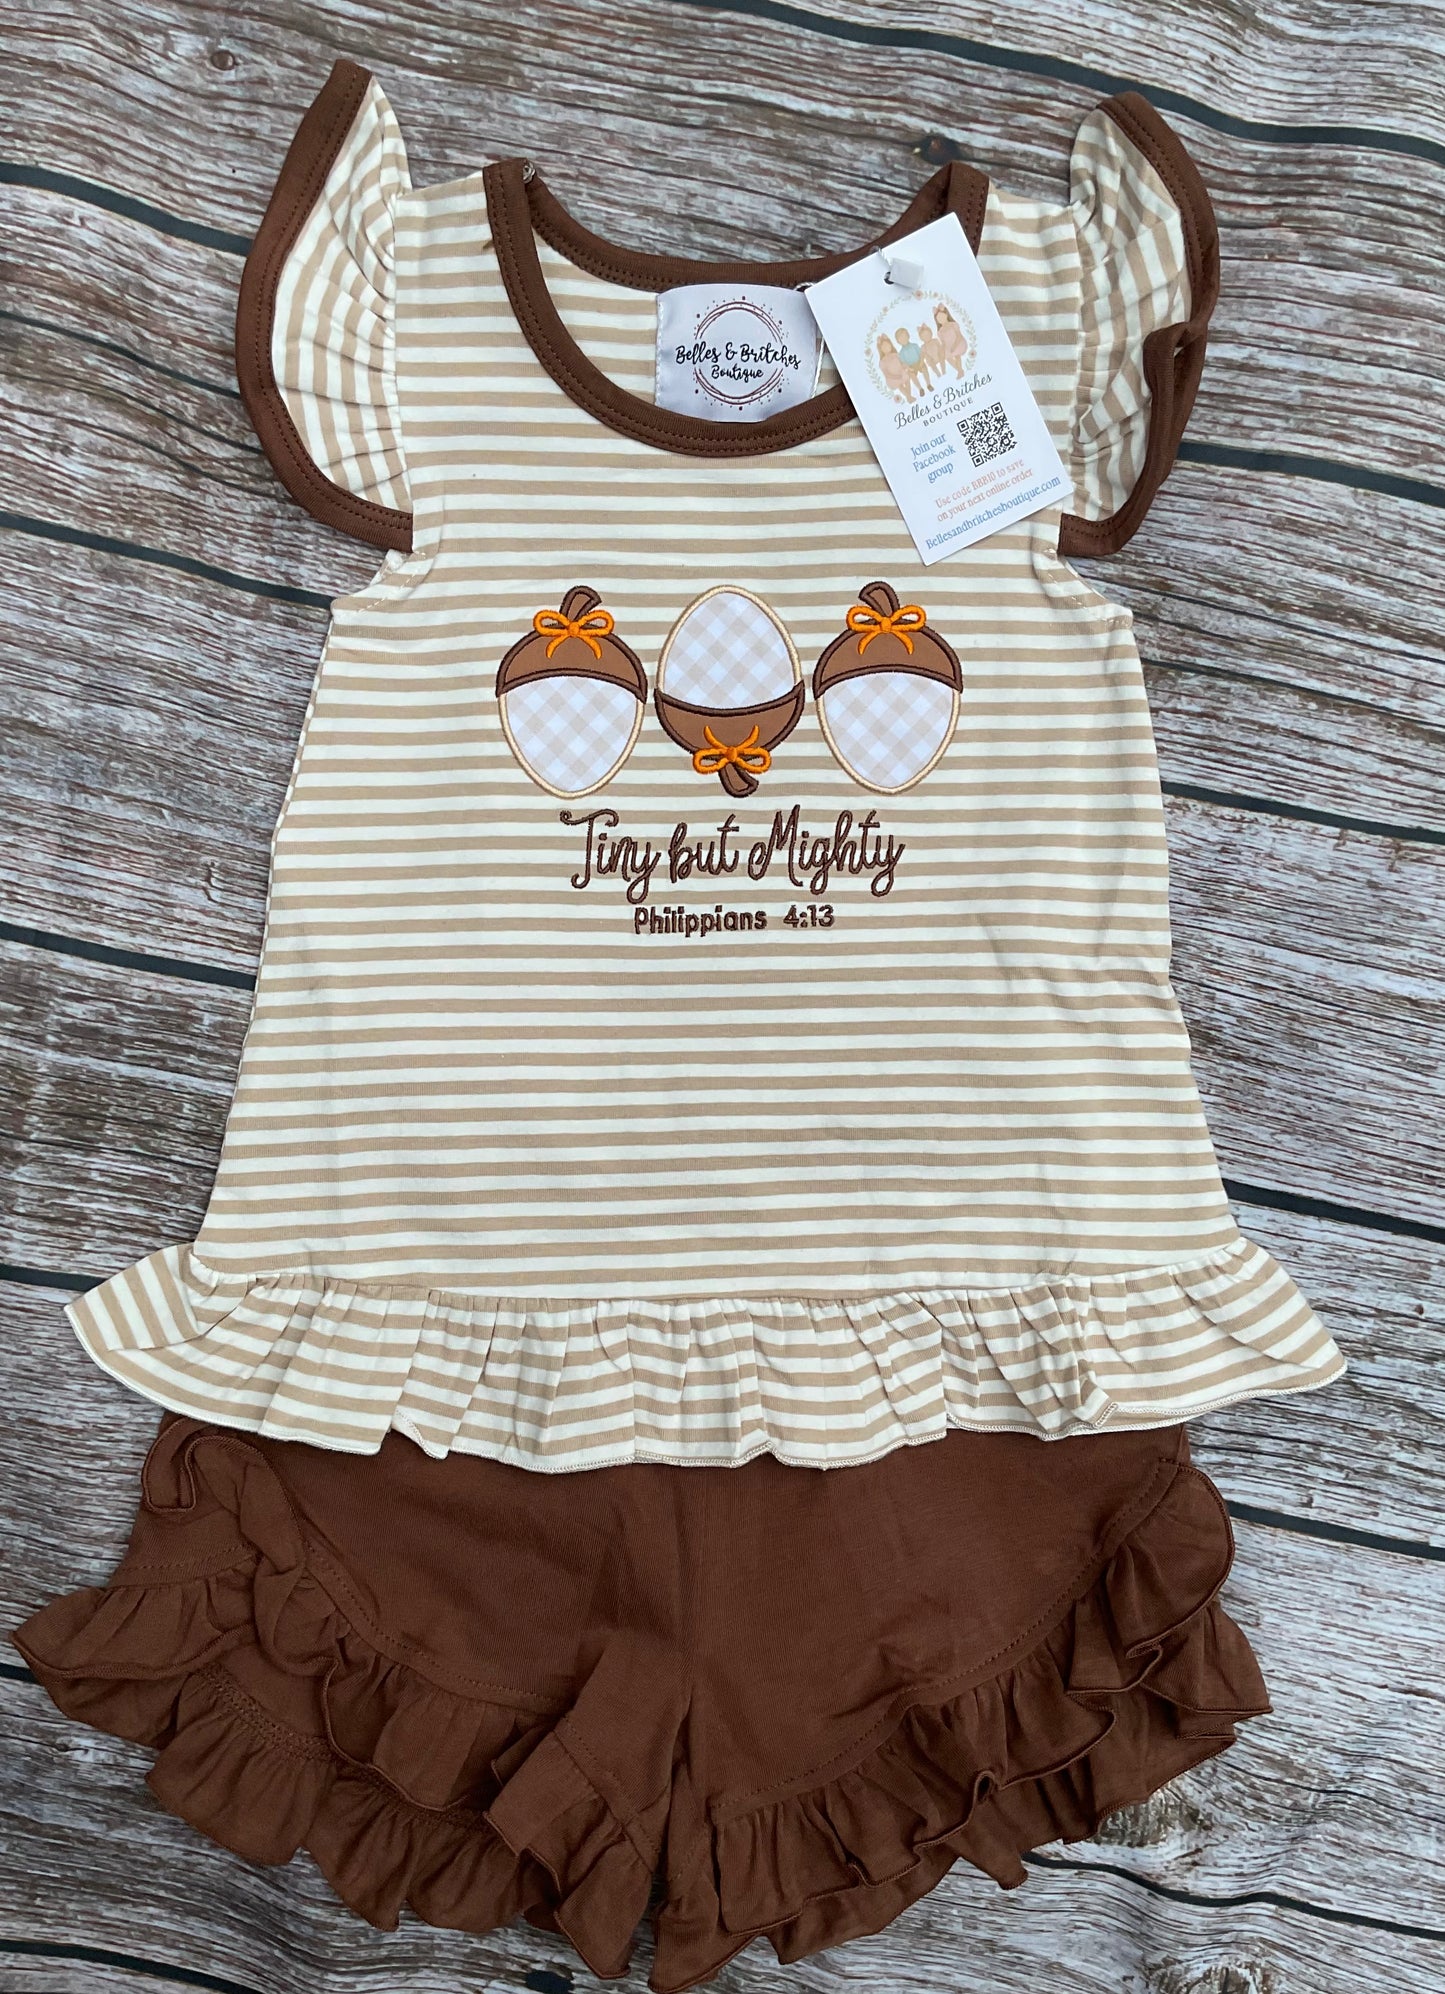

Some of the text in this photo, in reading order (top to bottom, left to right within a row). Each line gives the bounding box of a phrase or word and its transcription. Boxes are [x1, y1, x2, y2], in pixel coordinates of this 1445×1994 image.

[676, 341, 801, 369] Belles & Britches
[711, 363, 764, 383] Boutique
[894, 373, 992, 430] Belles & Britches
[923, 397, 974, 427] BOUTIQUE
[911, 433, 947, 460] Join our
[913, 444, 956, 472] Facebook
[928, 462, 954, 484] group
[935, 496, 951, 508] Use
[952, 485, 972, 500] code
[996, 468, 1006, 478] to
[1007, 459, 1025, 473] save
[937, 468, 1033, 522] on your next online order
[925, 476, 1061, 550] Bellesandbritchesboutique.com
[559, 804, 906, 904] Tiny but Mighty
[634, 904, 835, 938] Philippians 4:13
